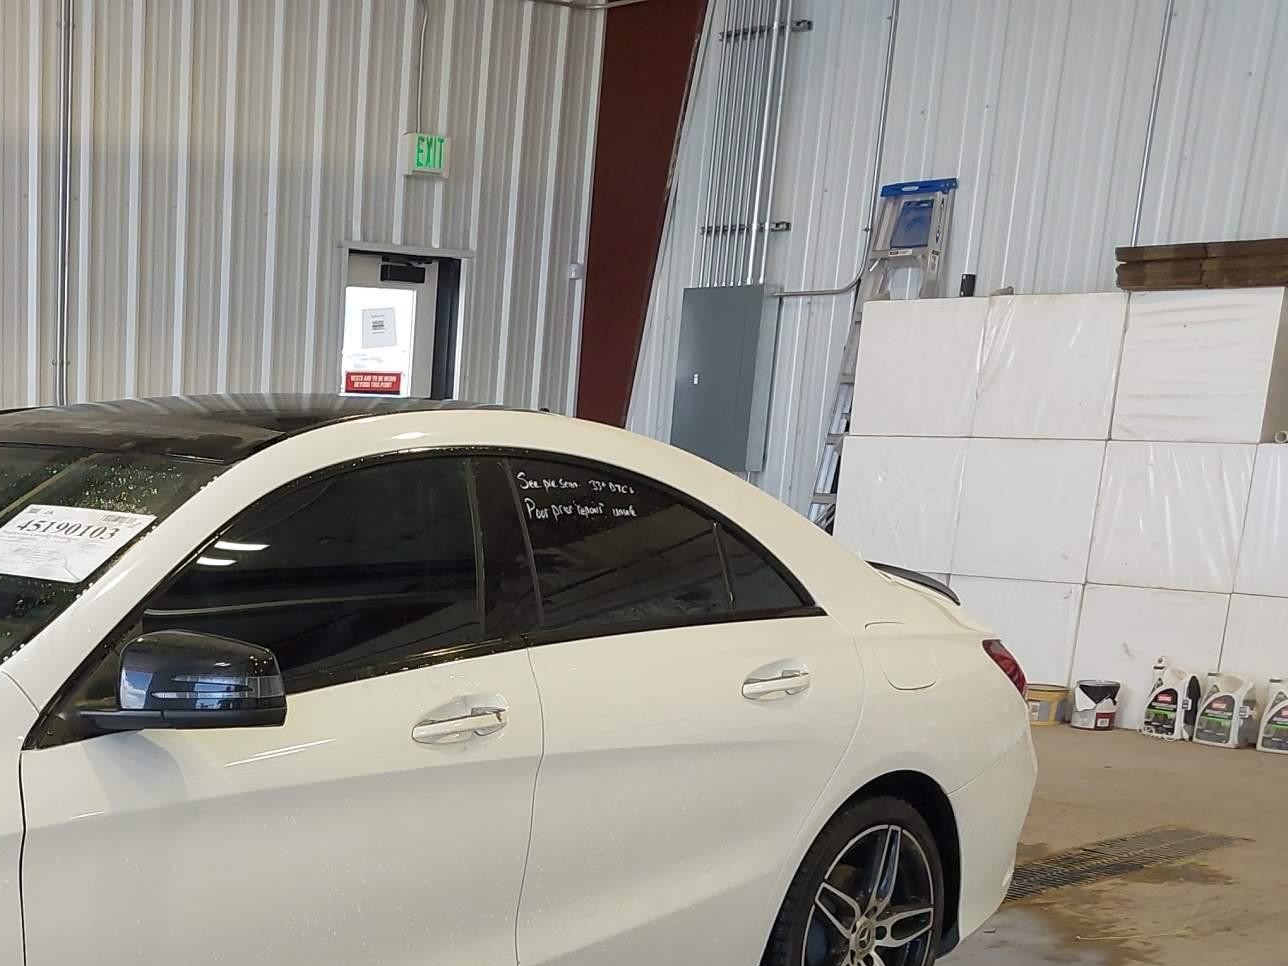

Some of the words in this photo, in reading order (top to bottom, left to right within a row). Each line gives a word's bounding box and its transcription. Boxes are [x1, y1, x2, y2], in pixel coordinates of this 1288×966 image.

[417, 136, 444, 168] EXIT
[517, 471, 542, 489] See
[524, 497, 549, 519] Poor
[17, 519, 120, 540] 45190103
